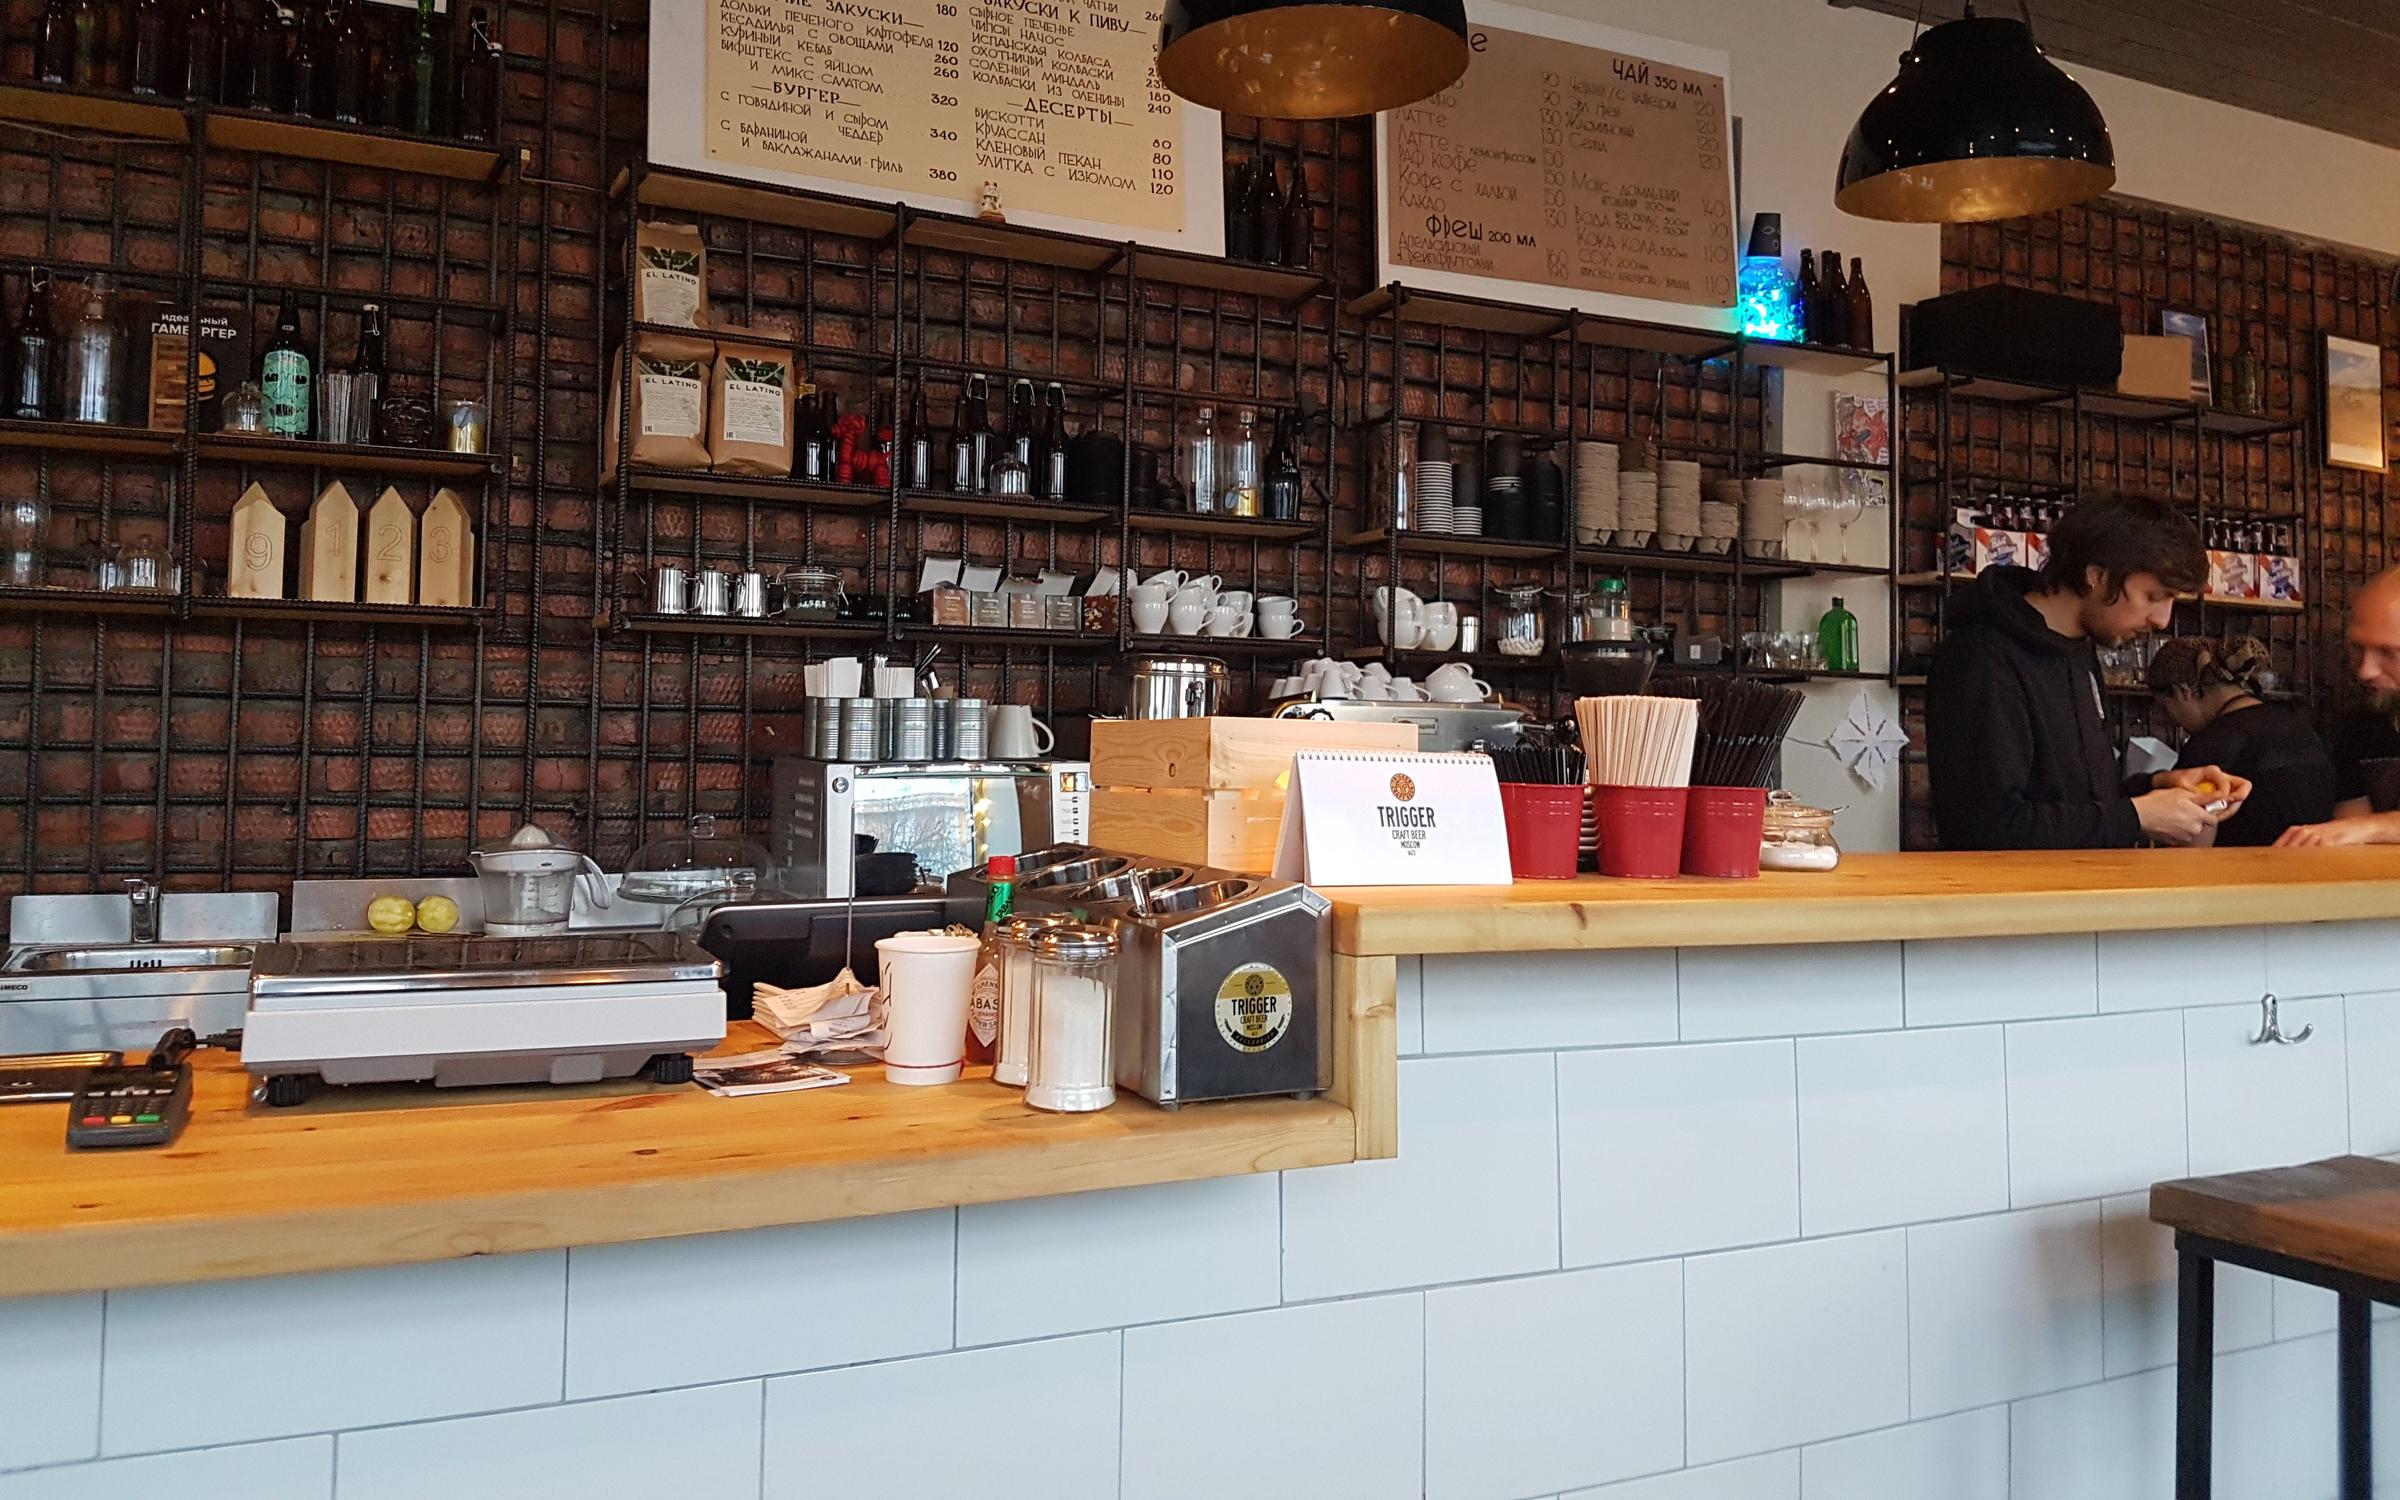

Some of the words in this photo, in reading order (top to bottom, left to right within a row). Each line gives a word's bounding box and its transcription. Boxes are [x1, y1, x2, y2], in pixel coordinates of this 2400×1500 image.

[720, 0, 771, 17] ДОЛЬКИ
[785, 10, 854, 32] ПЕЧЕНОГО
[866, 25, 934, 49] КАРТОФЕЛЯ
[937, 40, 959, 52] 120
[826, 0, 904, 25] ЗАКУСКИ
[936, 4, 958, 17] 180
[969, 6, 1014, 25] СЫРНОЕ
[1024, 17, 1075, 37] ПЕЧЕНЬЕ
[1069, 9, 1081, 24] К
[1090, 14, 1130, 32] ПИВУ
[721, 11, 794, 35] КЕСАДИЛЬЯ
[807, 29, 818, 39] С
[829, 32, 894, 54] ОВОЩАМИ
[934, 54, 959, 65] 260
[971, 20, 1011, 37] ЧИПСЫ
[1020, 28, 1065, 47] НАЧОС
[972, 32, 1047, 57] ИСПАНСКАЯ
[1058, 50, 1112, 69] КОЛБАСА
[720, 24, 781, 46] КУРИНЫЙ
[797, 40, 833, 56] КЕБАБ
[933, 67, 959, 79] 260
[721, 39, 792, 63] БИФШТЕКС
[803, 56, 814, 66] С
[824, 59, 874, 77] ЯЙЦОМ
[971, 45, 1044, 68] ОХОТНИЧЬИ
[1051, 60, 1115, 81] КОЛБАСКИ
[750, 60, 759, 71] И
[771, 64, 814, 81] МИКС
[931, 93, 958, 107] 320
[969, 58, 1030, 77] СОЛЕНЫЙ
[1042, 73, 1101, 91] МИНДАЛЬ
[1149, 92, 1171, 103] 180
[1613, 59, 1649, 85] ЧАЙ
[1655, 75, 1678, 91] 350
[773, 82, 840, 104] БУРГЕР
[973, 71, 1036, 92] КОЛБАСКИ
[1047, 85, 1063, 97] ИЗ
[1072, 89, 1125, 108] ОЛЕНИНЫ
[1147, 104, 1172, 115] 240
[720, 91, 730, 101] С
[738, 93, 811, 117] ГОВЯДИНОЙ
[825, 110, 834, 121] И
[843, 112, 889, 131] СЫРОМ
[1024, 97, 1113, 125] ДЕСЕРТЫ
[720, 119, 731, 131] С
[740, 122, 808, 144] БАРАНИНОЙ
[838, 125, 884, 146] ЧЕДДЕР
[930, 128, 957, 141] 340
[975, 108, 1045, 130] БИСКОТТИ
[1152, 139, 1172, 149] 80
[975, 121, 1046, 146] КРУАССАН
[1152, 154, 1172, 166] 80
[741, 137, 750, 148] И
[929, 168, 957, 182] 380
[976, 138, 1046, 161] КЛЕНОВЫЙ
[1058, 152, 1101, 170] ПЕКАН
[1151, 168, 1174, 181] 110
[976, 153, 1034, 175] УЛИТКА
[1044, 166, 1055, 177] С
[1068, 169, 1136, 191] ИЗЮМОМ
[1150, 182, 1174, 195] 120
[1488, 230, 1511, 244] 200
[646, 271, 657, 279] EL
[662, 272, 697, 286] LATINO
[645, 376, 658, 384] EL
[662, 377, 698, 390] LATINO
[745, 384, 781, 397] LATINO
[245, 532, 273, 571] 9
[326, 519, 342, 559] 1
[376, 524, 403, 561] 2
[428, 526, 452, 563] 3
[1377, 806, 1436, 828] TRIGGER
[1392, 829, 1410, 840] CRAFT
[1411, 829, 1427, 840] BEER
[1400, 840, 1421, 848] MOSCOW
[1232, 996, 1277, 1016] TRIGGER
[1240, 1016, 1255, 1025] CRAFT
[1256, 1014, 1268, 1023] BEER
